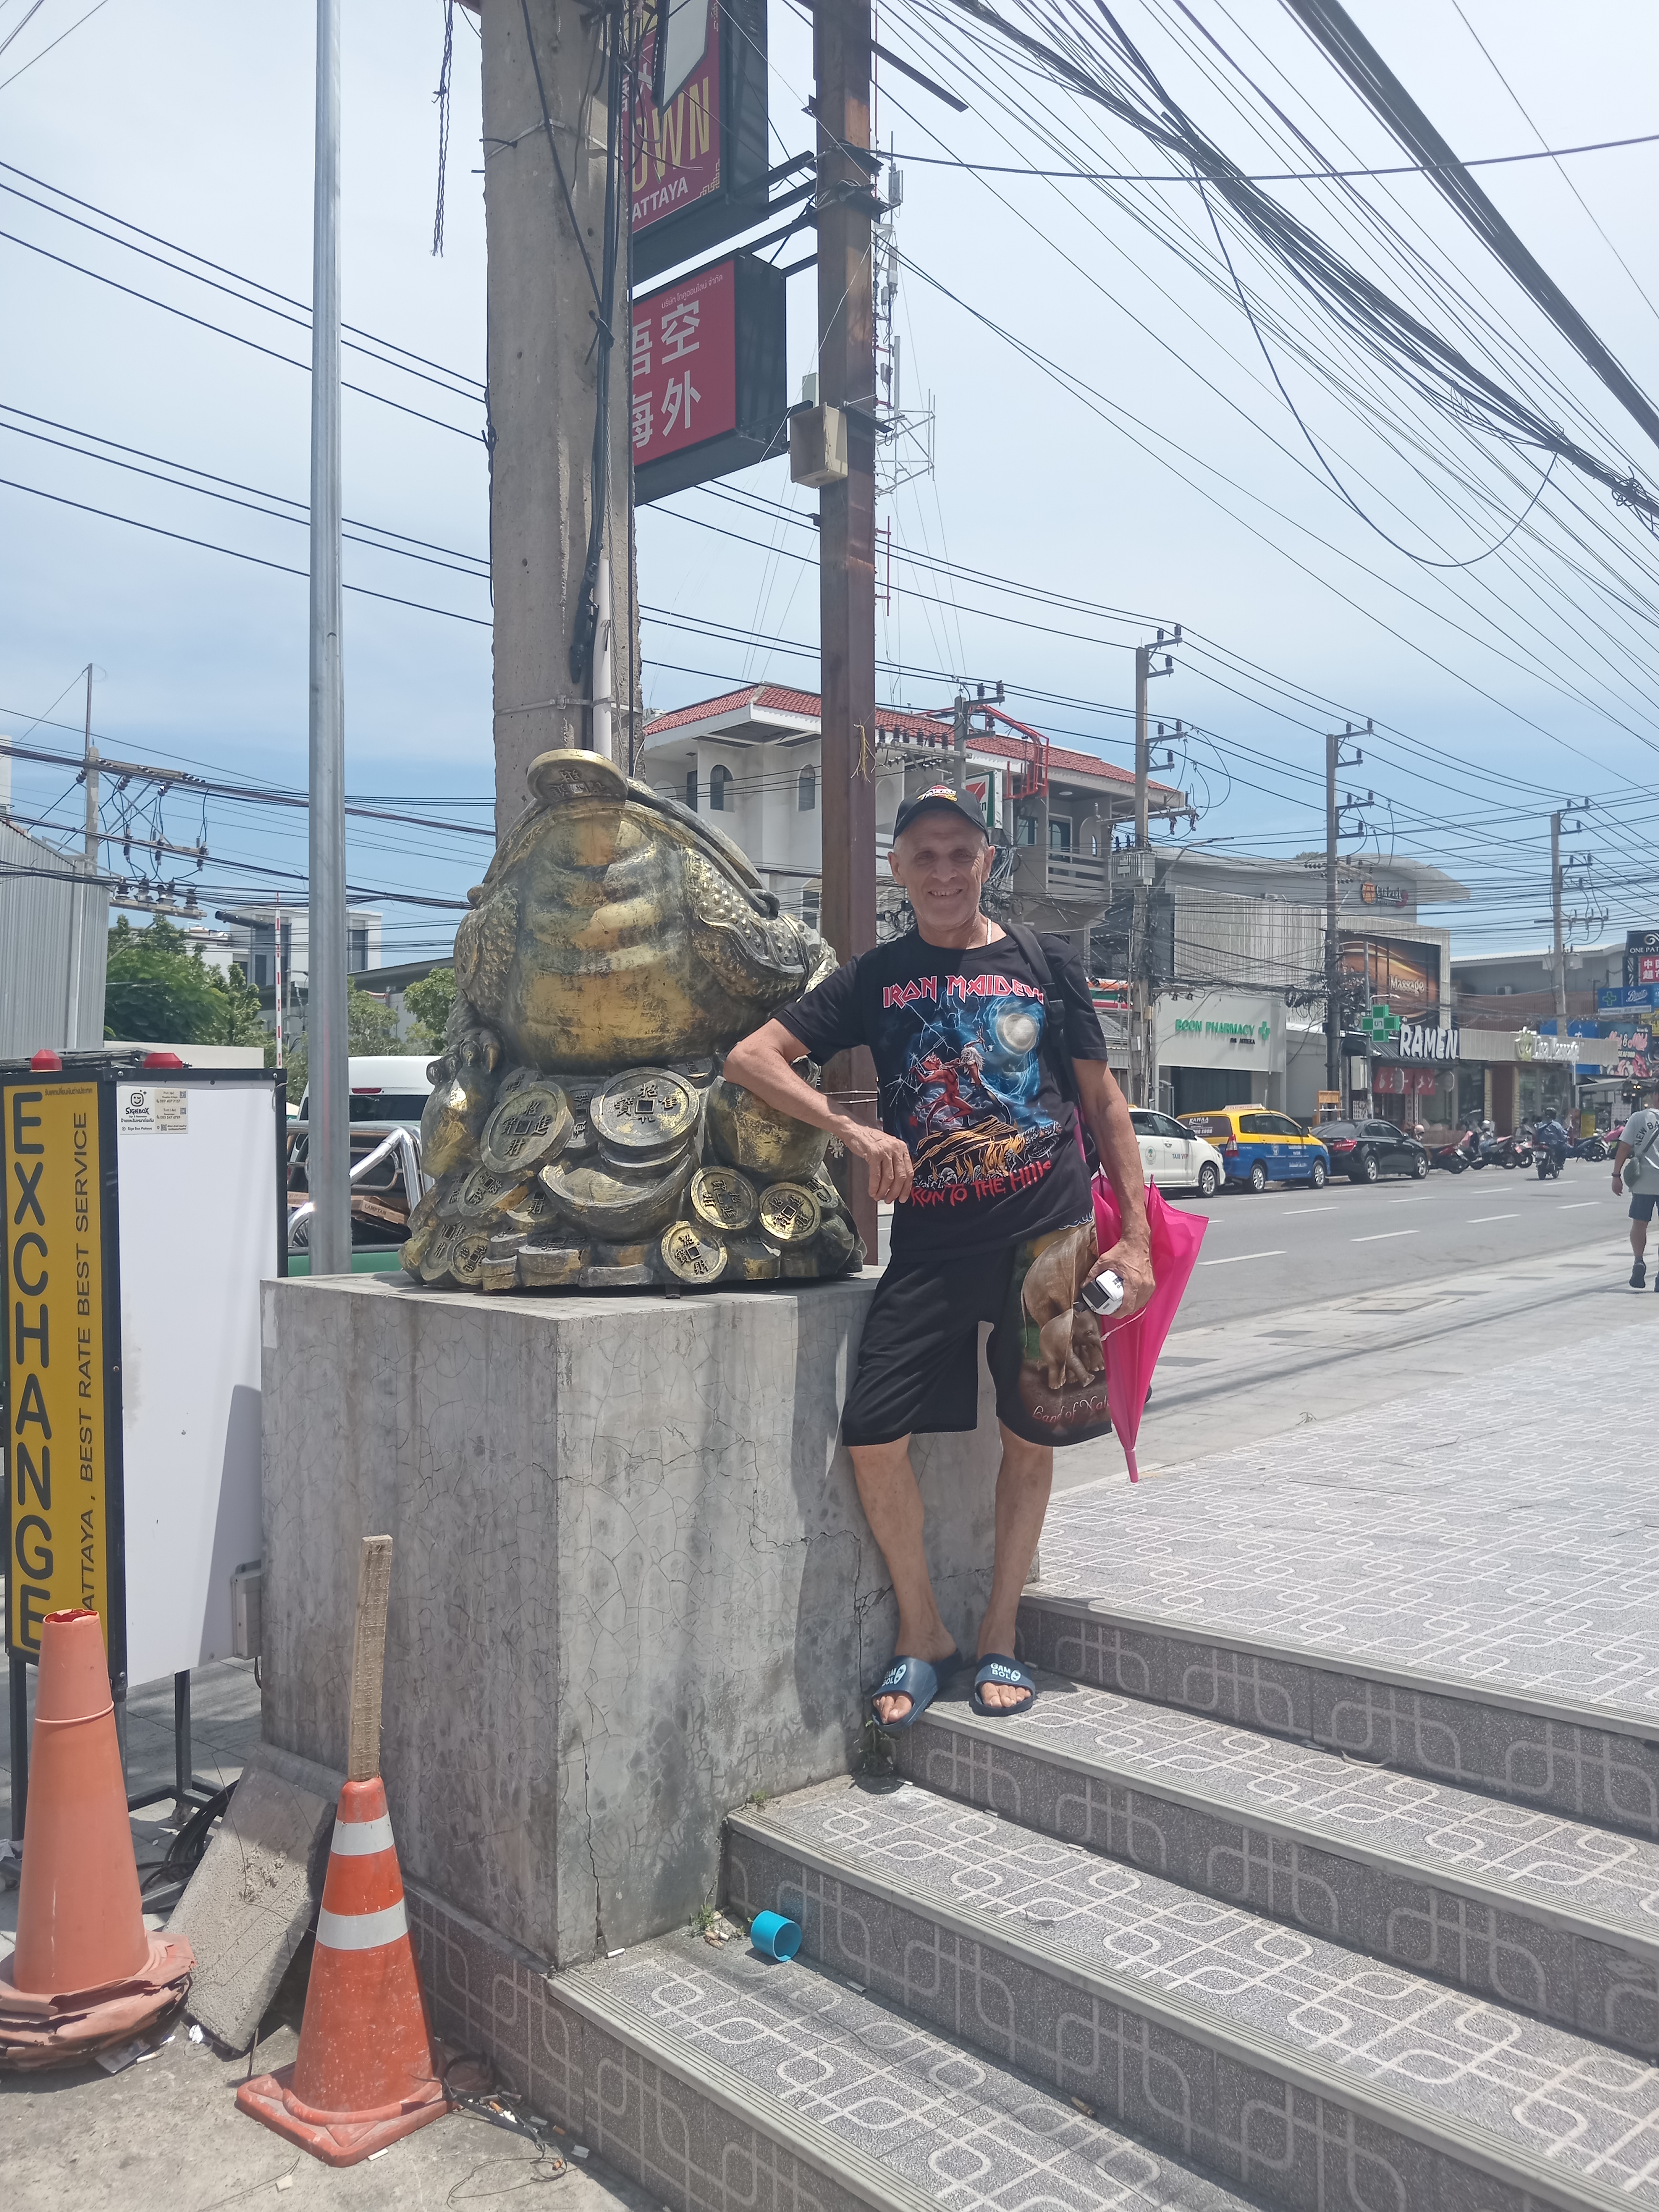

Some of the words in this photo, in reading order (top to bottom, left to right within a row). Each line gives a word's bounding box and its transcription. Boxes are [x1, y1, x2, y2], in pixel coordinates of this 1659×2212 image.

[632, 76, 709, 192] OWN
[626, 176, 688, 222] ATTAYA
[883, 976, 938, 1009] IRON
[945, 974, 1044, 1005] MAIDEN
[1389, 975, 1425, 996] Massage
[1176, 1019, 1202, 1032] BOON
[1205, 1022, 1255, 1036] PHARMACY
[1400, 1024, 1458, 1060] RAMEN
[74, 1112, 88, 1232] SERVICE
[364, 1204, 386, 1216] LAMPTAN
[910, 1186, 945, 1208] RUN
[944, 1184, 967, 1206] TO
[970, 1177, 1006, 1201] THE
[77, 1243, 90, 1316] BEST
[13, 1091, 53, 1650] EXCHANGE
[78, 1328, 91, 1398] RATE
[1032, 1406, 1065, 1423] Land
[1065, 1402, 1079, 1423] of
[1079, 1395, 1109, 1412] Nat
[80, 1408, 93, 1482] BEST
[81, 1510, 95, 1610] ATTAYA
[990, 1662, 1011, 1674] GAM
[992, 1669, 1011, 1680] BOL
